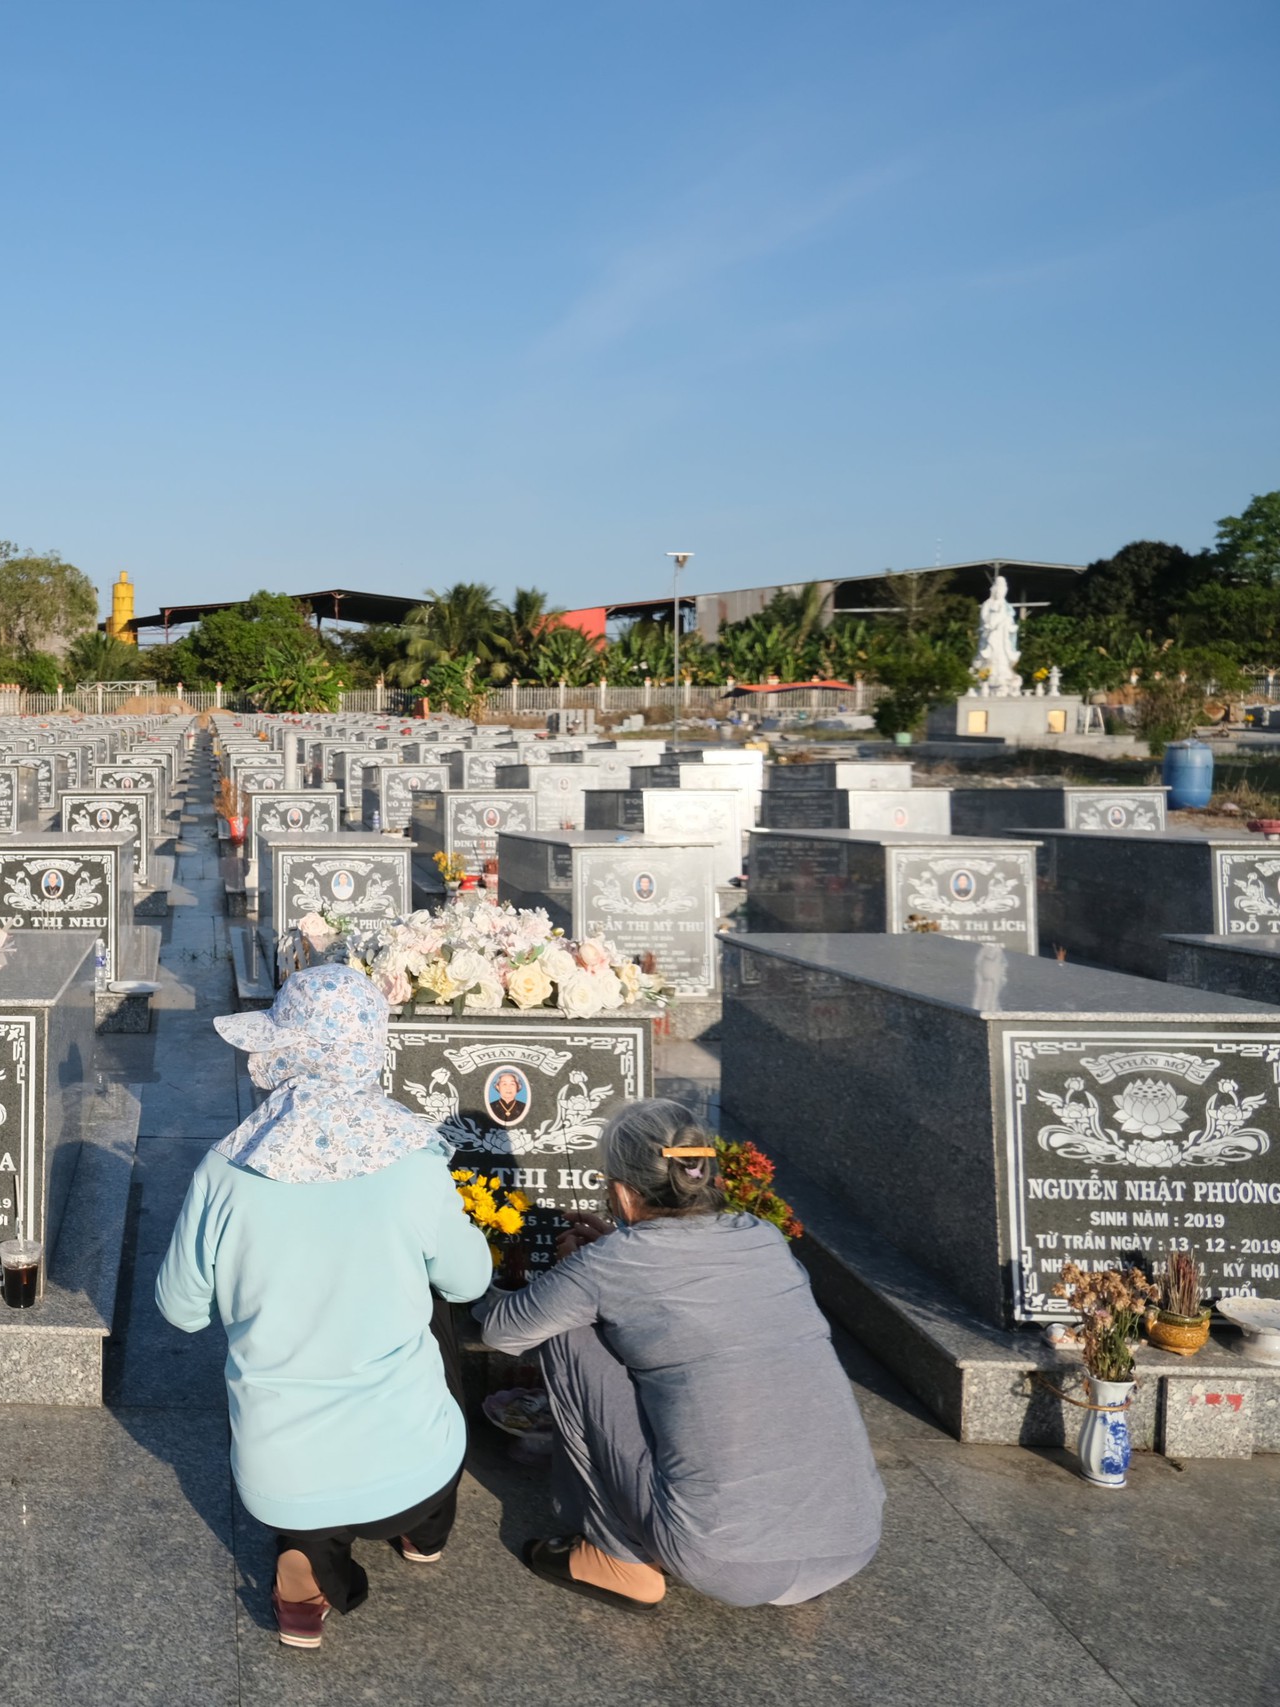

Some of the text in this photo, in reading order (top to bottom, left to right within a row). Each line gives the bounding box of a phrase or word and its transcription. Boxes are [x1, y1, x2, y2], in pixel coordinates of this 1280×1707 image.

[30, 916, 64, 929] THỊ
[1229, 913, 1260, 934] ĐỖ
[490, 1167, 548, 1194] THỊ
[1027, 1169, 1280, 1206] NGUYỄN NHẬT PHƯƠNG
[536, 1198, 556, 1209] 05
[1089, 1209, 1225, 1228] SINH NĂM 2019
[535, 1234, 553, 1245] 11
[1035, 1229, 1280, 1254] TỪ TRẦN NGÀY 13 12 2019
[530, 1251, 550, 1263] 82
[1223, 1257, 1245, 1278] KỶ
[1250, 1262, 1280, 1281] HỢI
